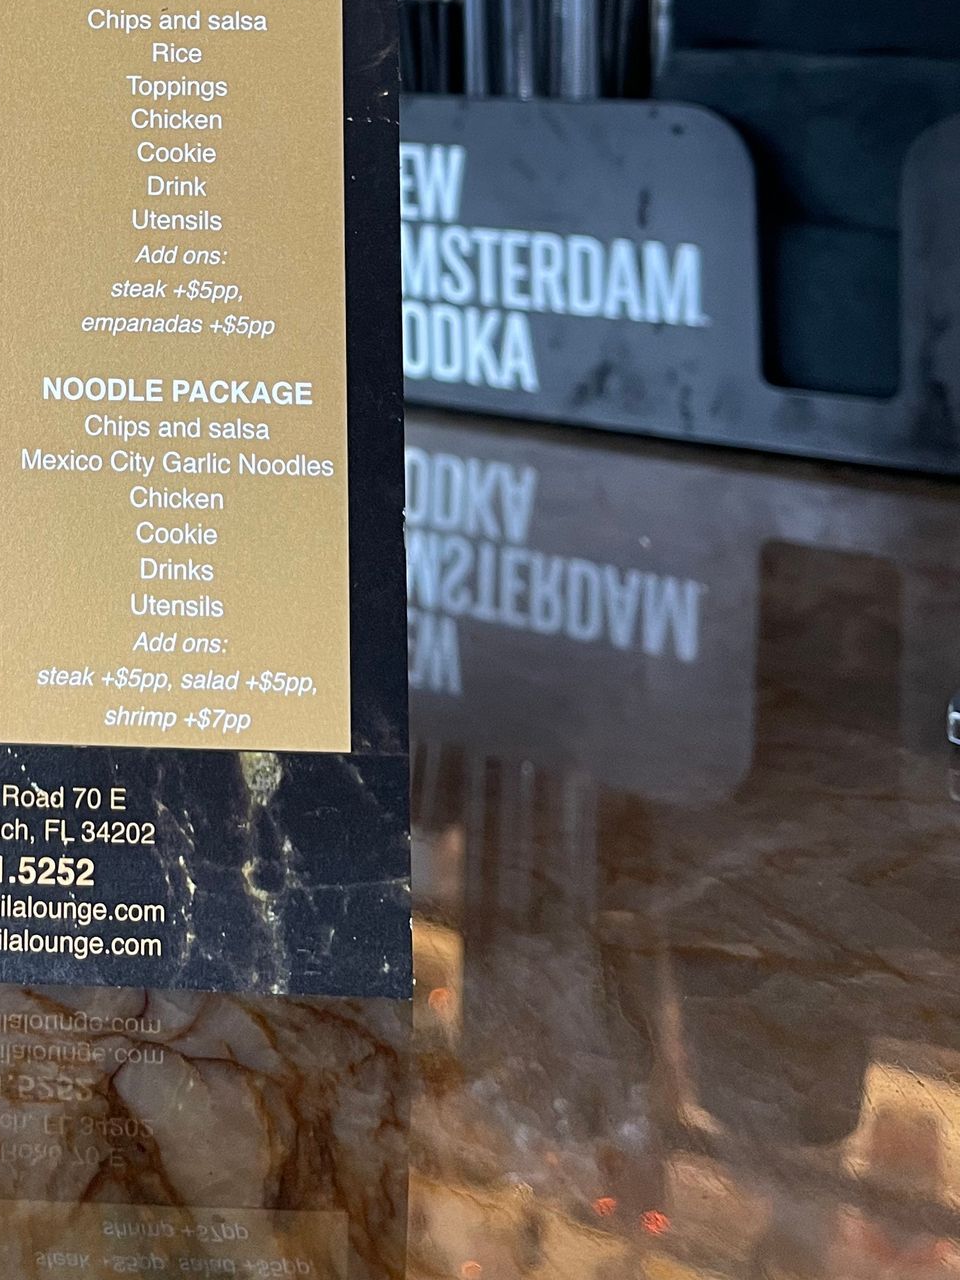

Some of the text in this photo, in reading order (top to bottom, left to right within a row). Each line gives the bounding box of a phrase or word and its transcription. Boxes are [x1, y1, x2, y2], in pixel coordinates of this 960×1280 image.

[88, 9, 267, 33] Chips and salsa
[153, 43, 201, 63] Rice
[126, 76, 227, 101] Toppings
[132, 109, 222, 129] Chicken
[138, 142, 216, 163] Cookie
[148, 176, 206, 196] Drink
[400, 142, 466, 222] EW
[133, 209, 222, 230] Utensils
[135, 245, 228, 264] Add ons:
[400, 222, 705, 328] MSTERDAM
[111, 279, 243, 303] steak +$5pp,
[82, 315, 276, 338] empanadas +$5pp
[402, 298, 538, 393] ODKA
[44, 377, 312, 404] NOODLE PACKAGE
[85, 415, 269, 441] Chips and salsa
[22, 449, 333, 477] Mexico City Garlic Noodles
[130, 486, 223, 509] Chicken
[136, 522, 217, 544] Cookie
[141, 558, 213, 581] Drinks
[131, 594, 223, 617] Utensils
[133, 632, 228, 653] Add ons:
[37, 667, 317, 696] steak +$5pp, salad +$5pp,
[104, 706, 252, 733] shrimp +$7pp
[2, 784, 64, 808] Road
[73, 787, 101, 809] 70
[110, 788, 127, 811] E
[44, 819, 75, 842] FL
[81, 821, 155, 845] 34202
